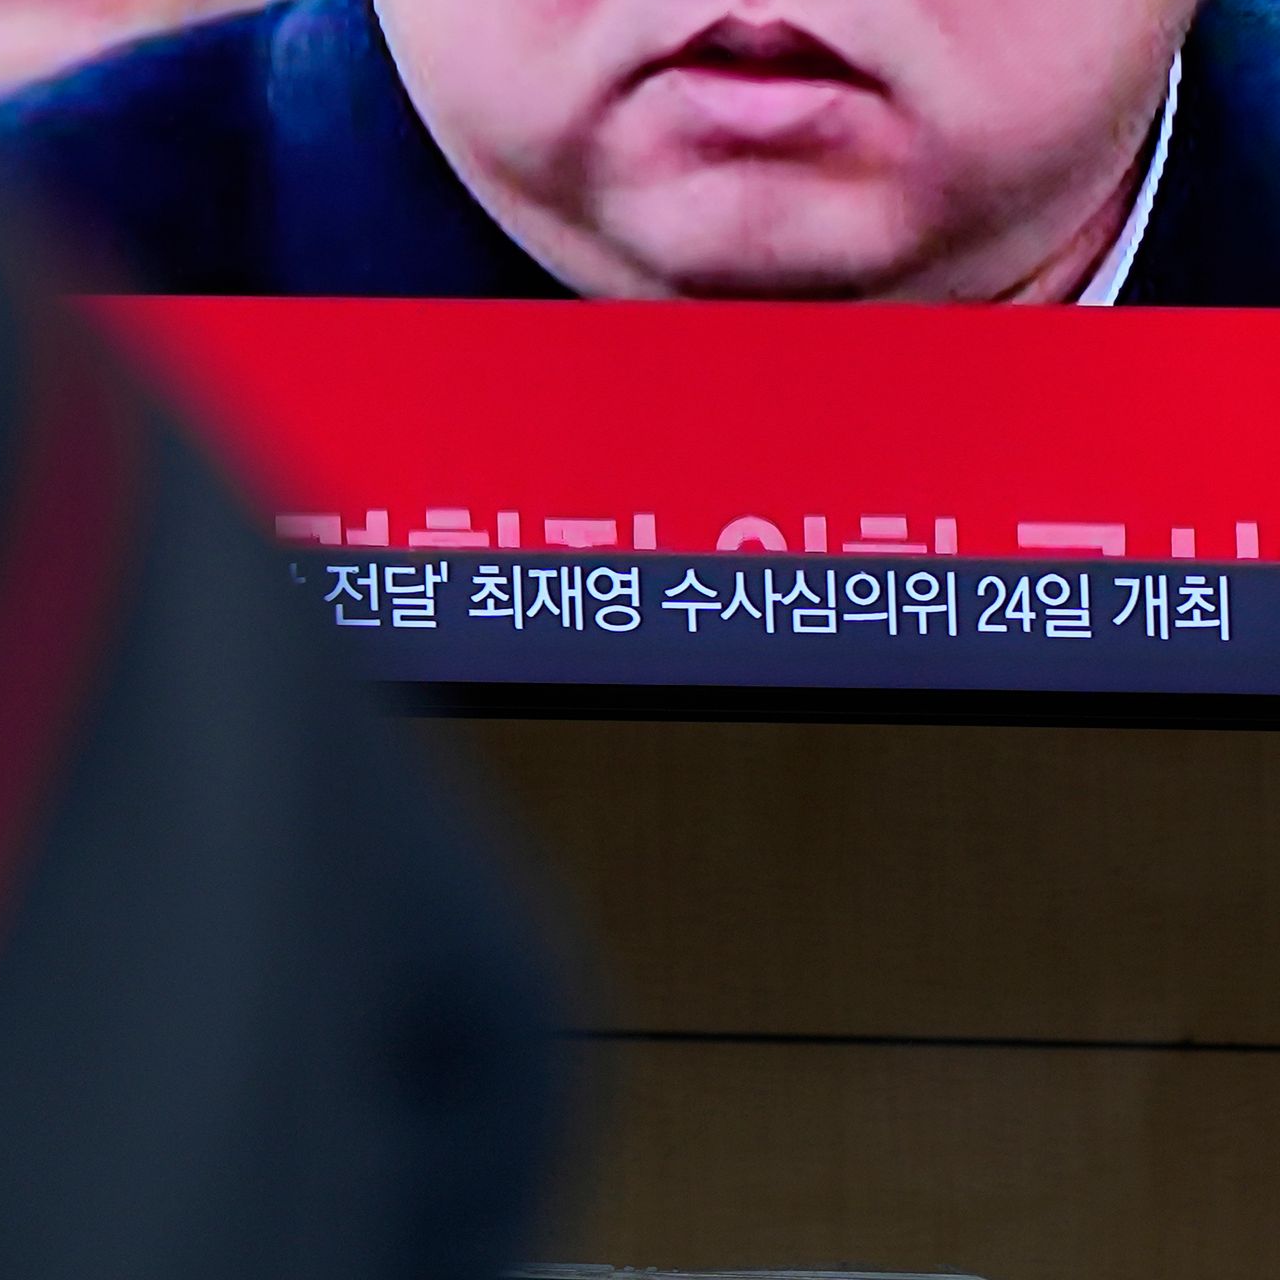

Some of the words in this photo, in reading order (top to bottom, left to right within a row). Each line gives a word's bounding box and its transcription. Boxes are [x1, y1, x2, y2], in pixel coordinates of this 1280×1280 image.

[323, 561, 448, 628] 전달'
[468, 564, 641, 634] 최재영
[661, 568, 957, 636] 수사심의위
[977, 571, 1092, 638] 24일
[1112, 574, 1230, 641] 개최
